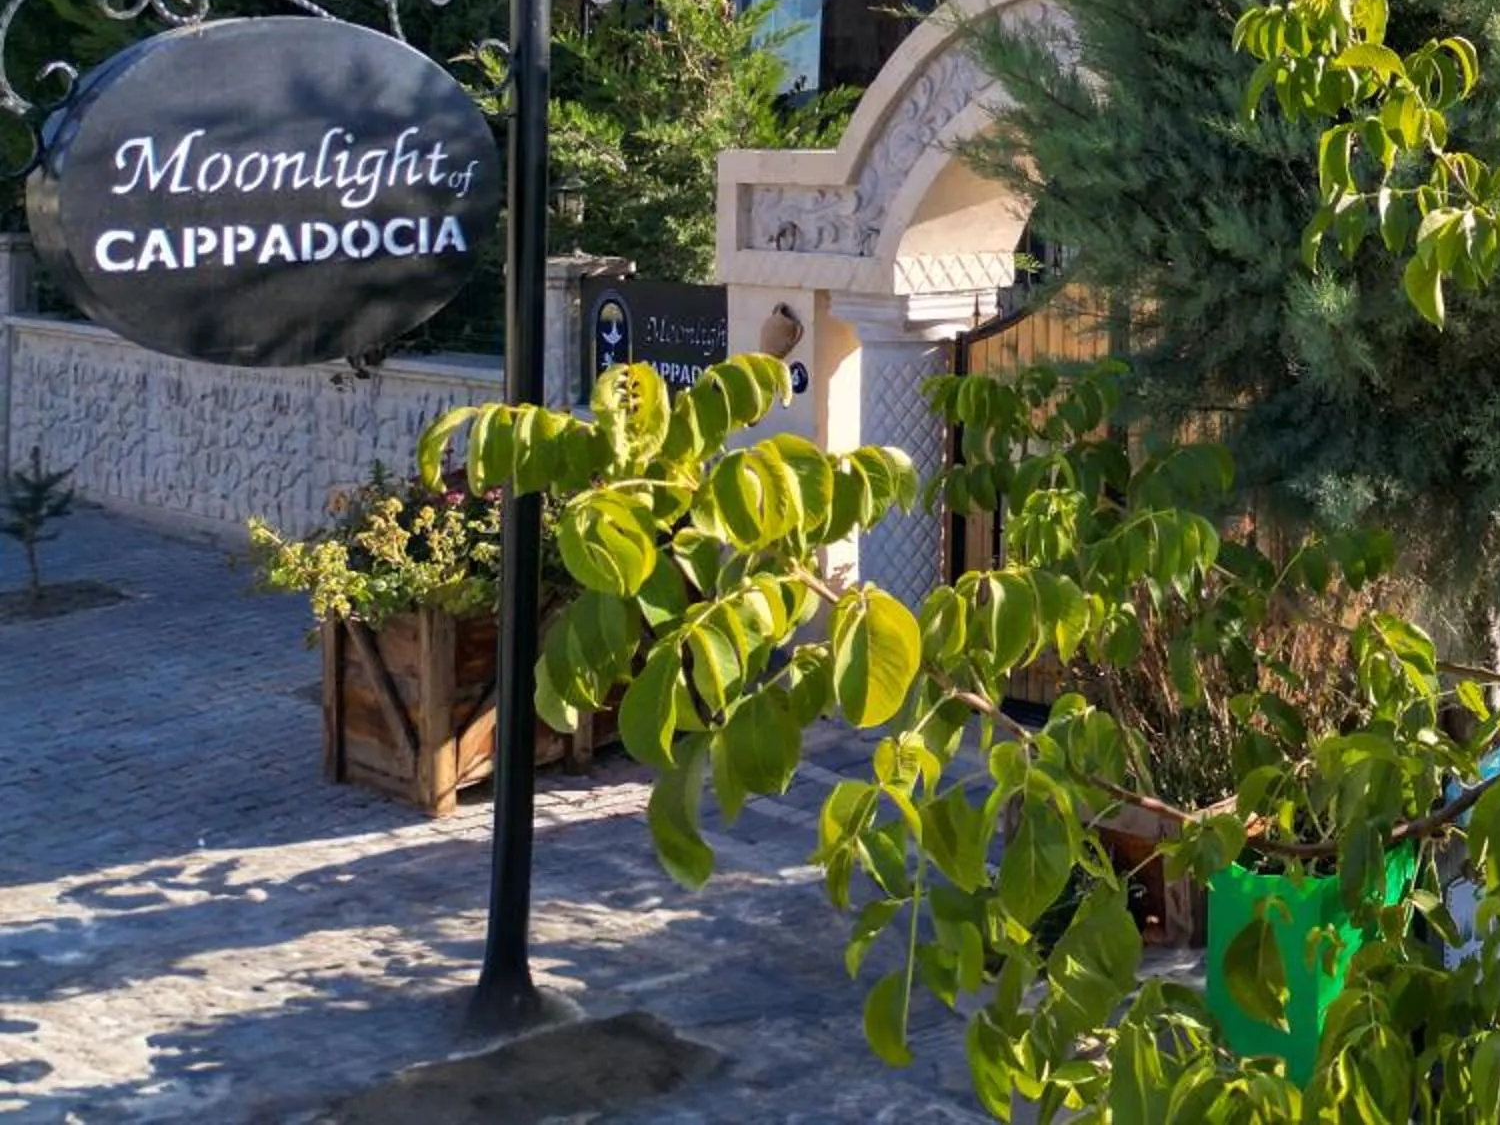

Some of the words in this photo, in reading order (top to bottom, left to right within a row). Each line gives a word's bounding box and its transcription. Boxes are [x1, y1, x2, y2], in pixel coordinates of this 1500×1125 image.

[111, 126, 450, 209] Moonlight
[448, 159, 480, 198] of
[94, 214, 467, 272] CAPPADOCIA
